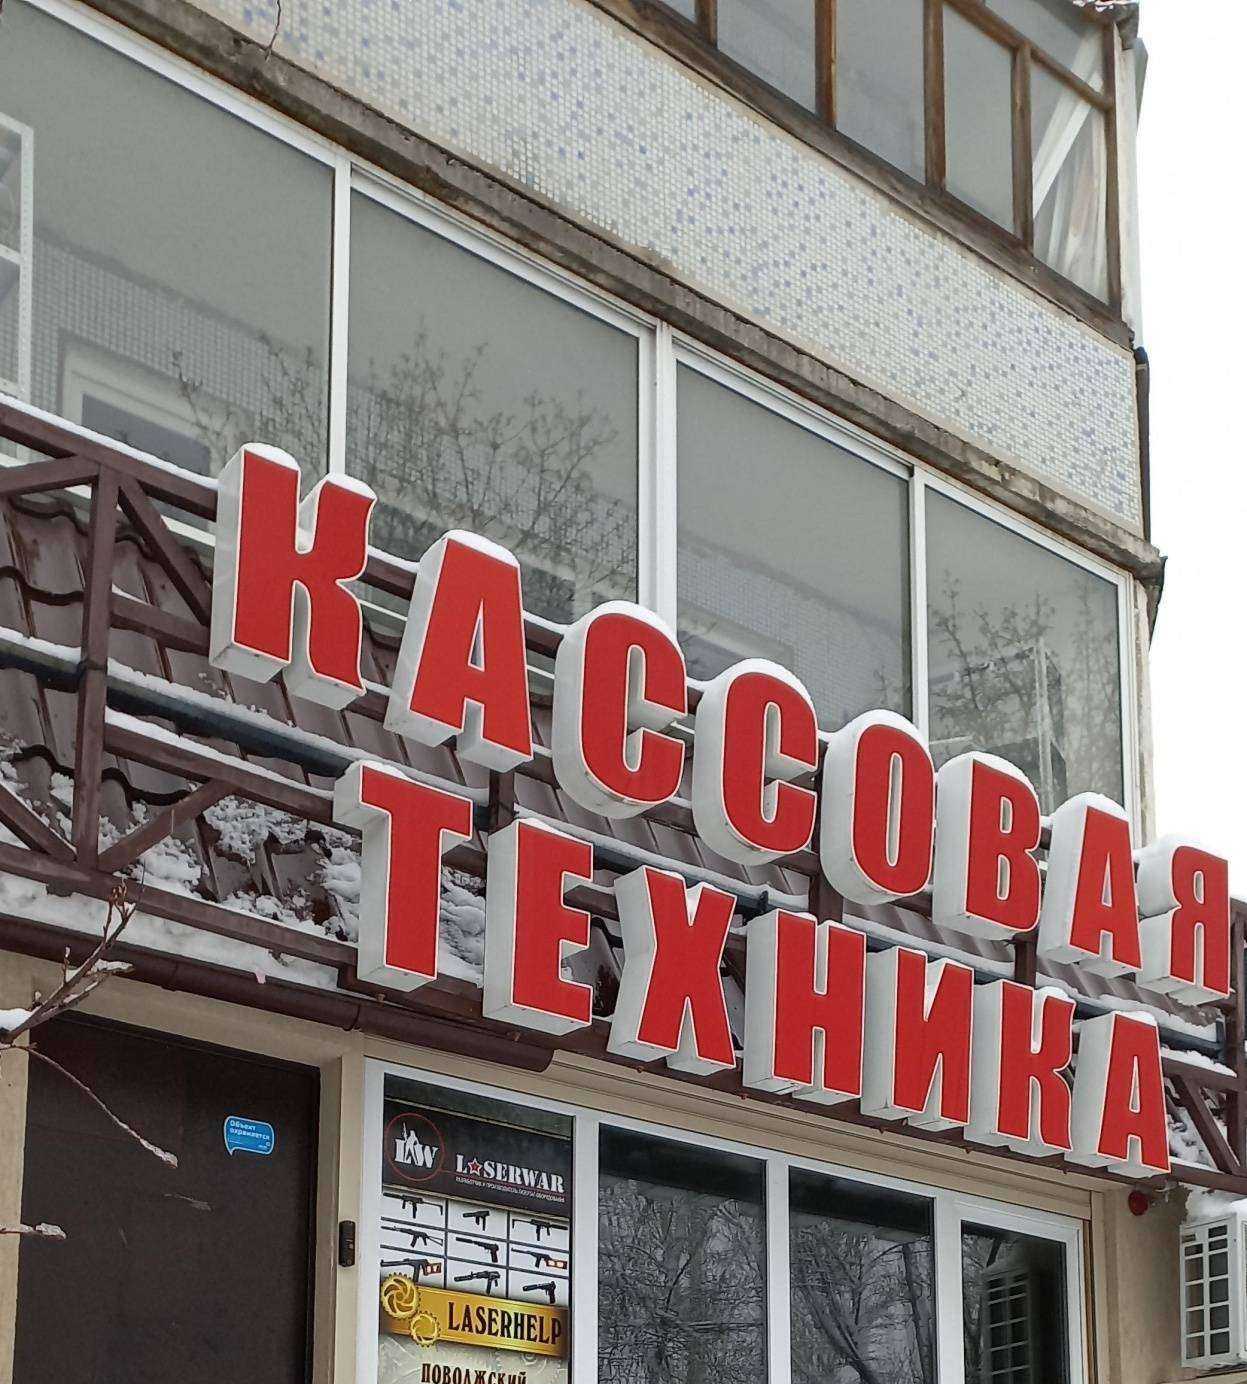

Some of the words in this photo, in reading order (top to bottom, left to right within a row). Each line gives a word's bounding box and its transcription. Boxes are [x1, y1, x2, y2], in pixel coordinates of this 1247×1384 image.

[226, 450, 1232, 1000] КАССОВАЯ
[354, 765, 1173, 1176] ТЕХНИКА
[448, 1301, 562, 1345] LASERHELP
